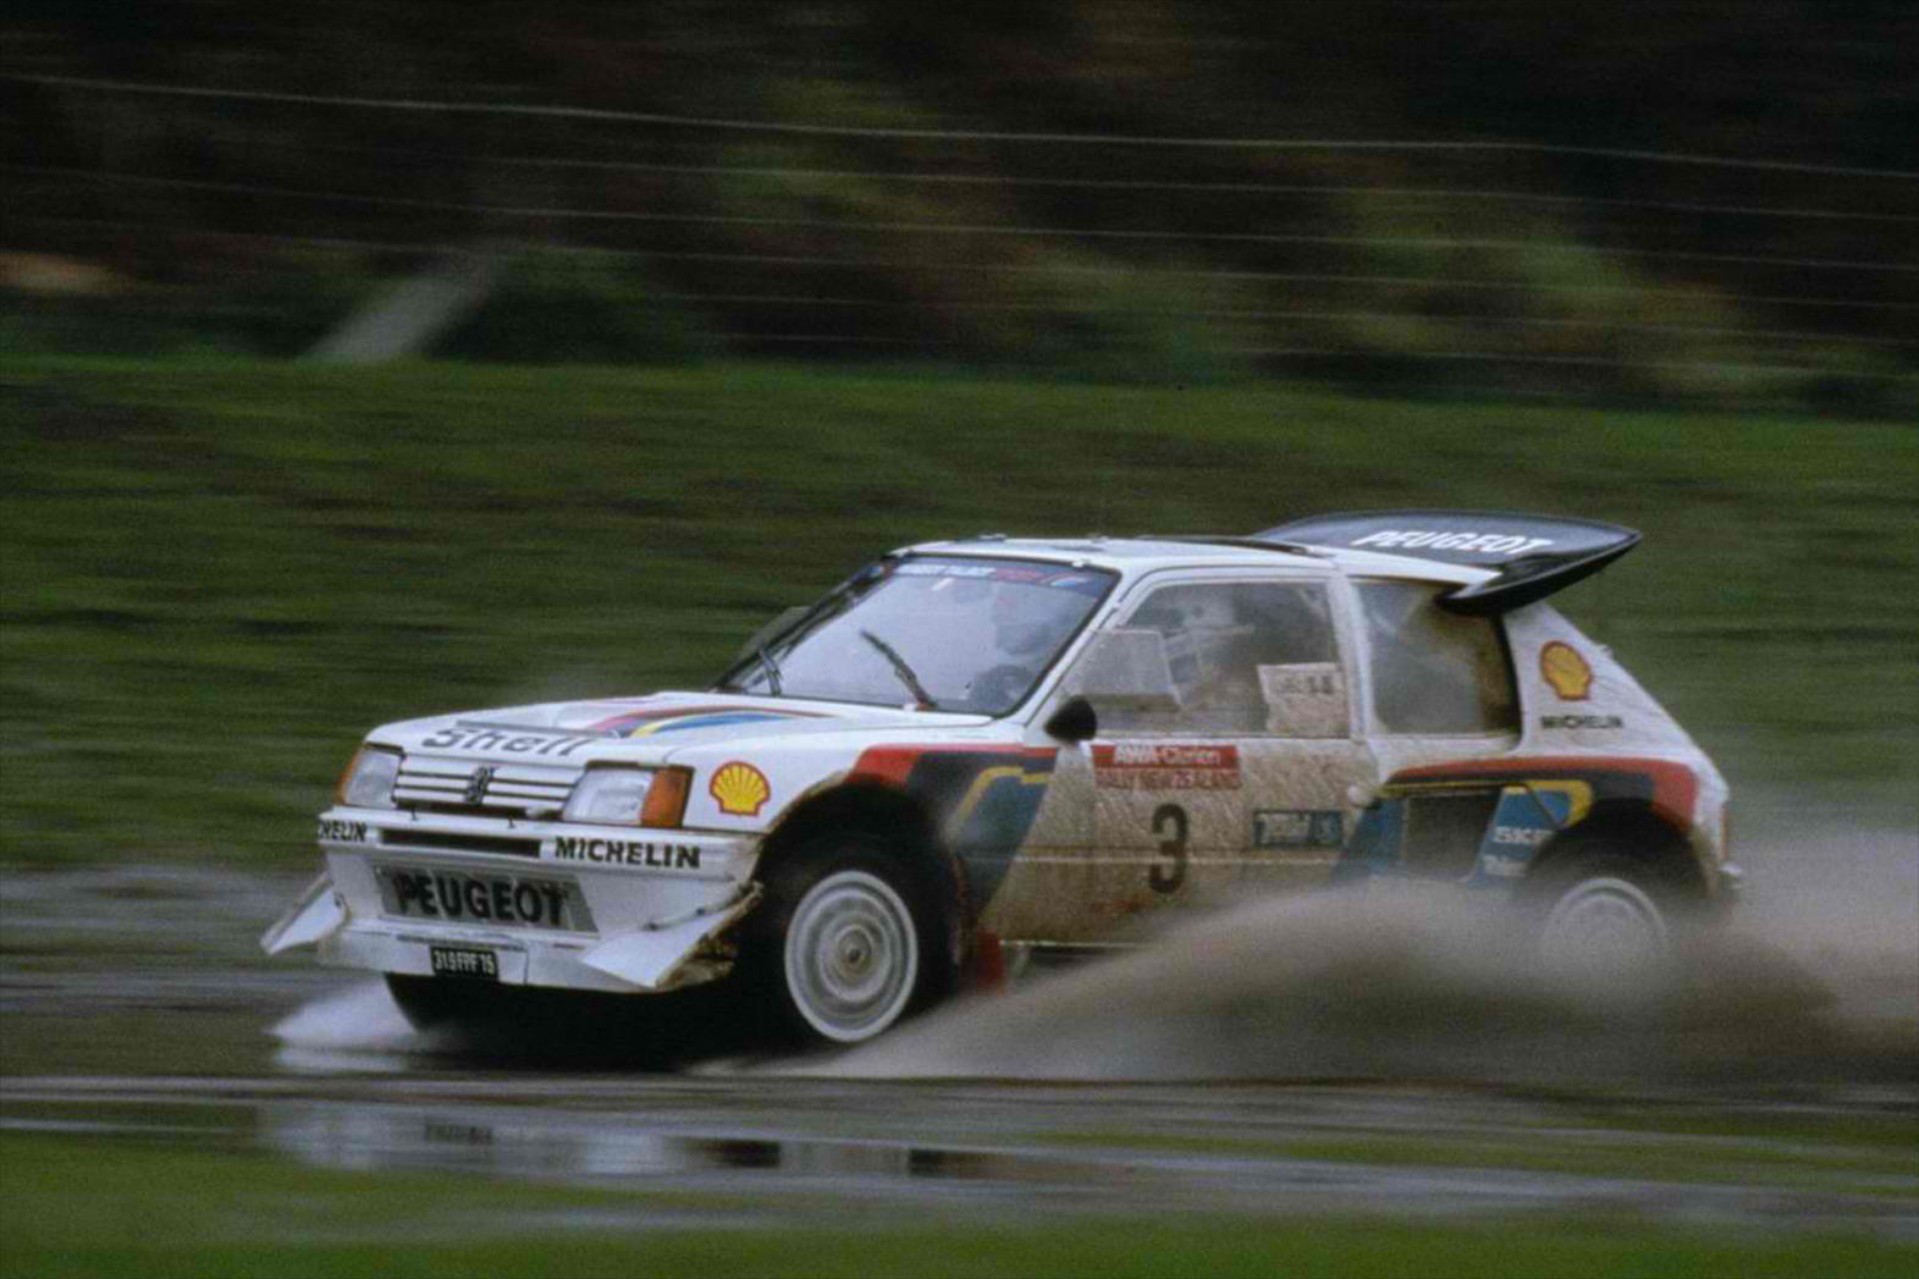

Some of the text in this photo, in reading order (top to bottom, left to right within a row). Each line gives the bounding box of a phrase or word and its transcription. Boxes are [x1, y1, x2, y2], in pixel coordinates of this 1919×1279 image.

[1350, 530, 1555, 555] PEUGEOT
[421, 728, 597, 757] Shell
[555, 835, 700, 868] MICHELIN
[1149, 803, 1188, 894] 3
[391, 869, 569, 926] PEUGEOT
